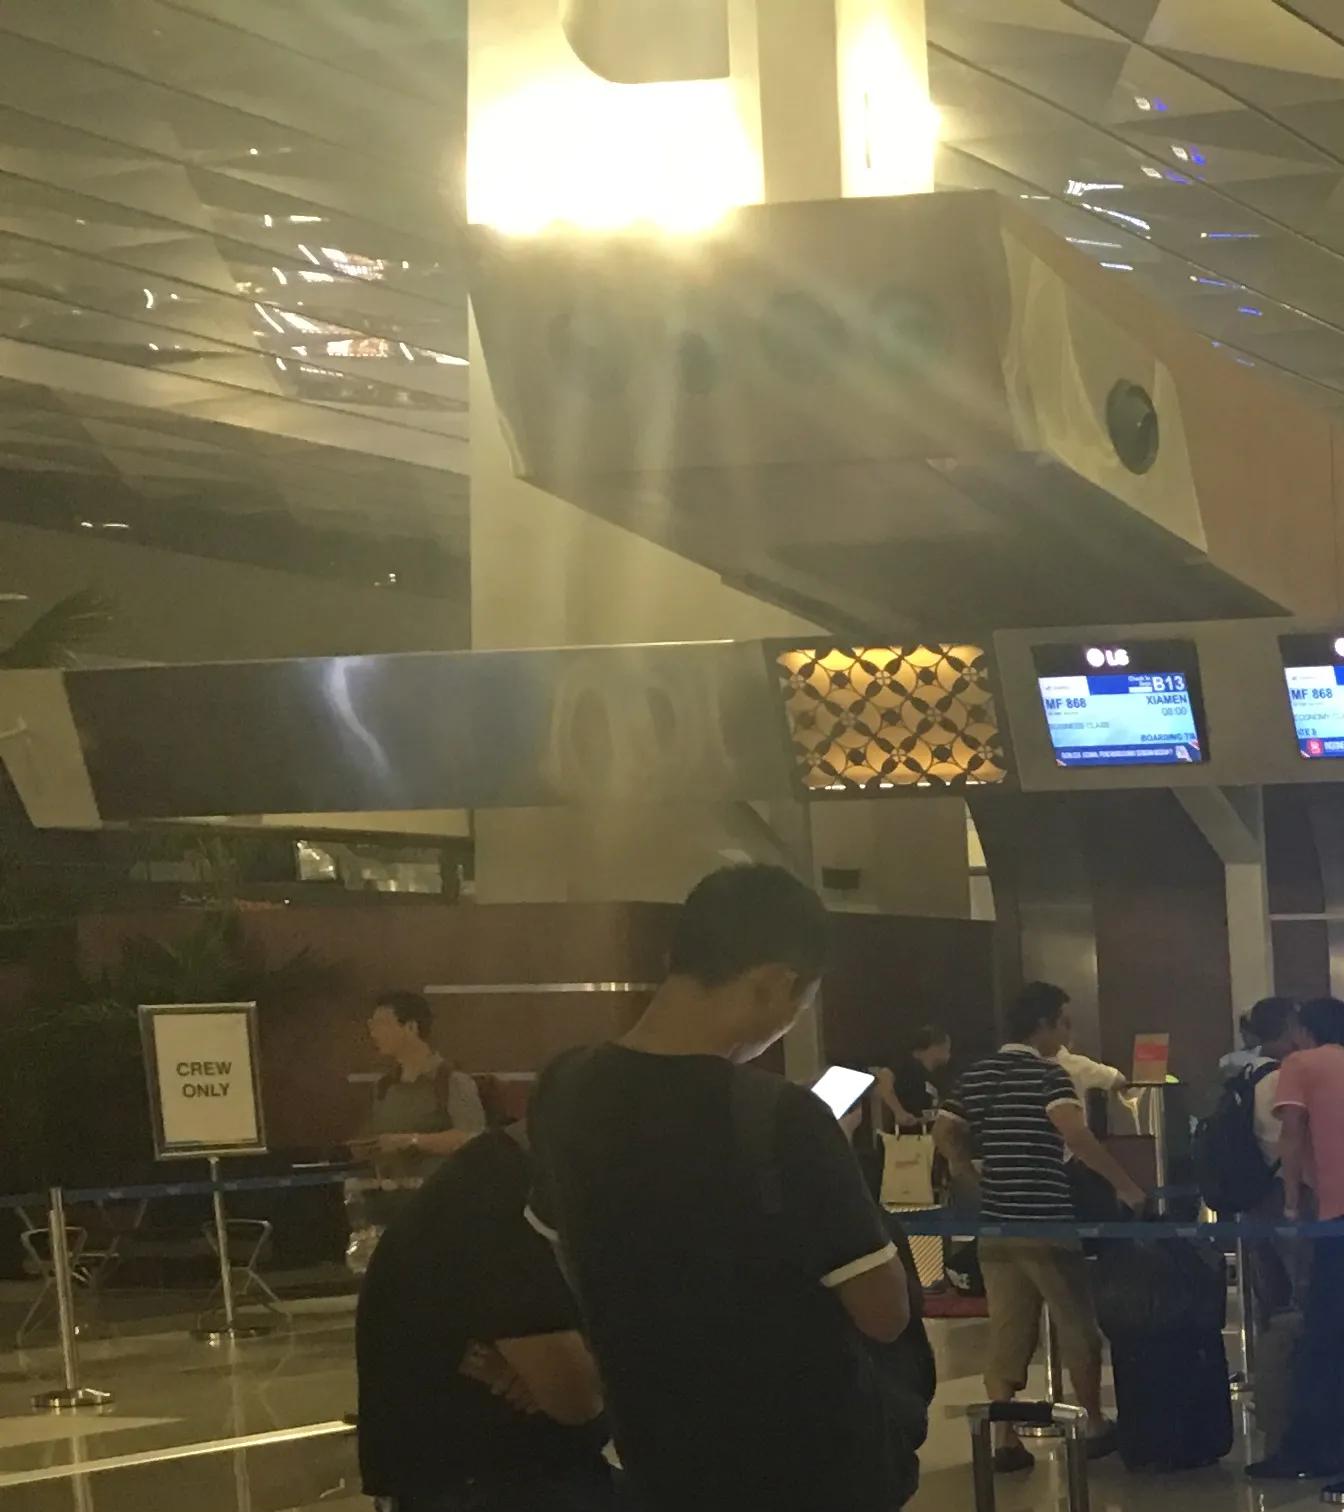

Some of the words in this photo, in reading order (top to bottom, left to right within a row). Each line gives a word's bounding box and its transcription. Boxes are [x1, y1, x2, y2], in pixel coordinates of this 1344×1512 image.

[1105, 649, 1129, 666] LG
[1152, 676, 1185, 691] B13
[1146, 695, 1187, 705] XIAMEN
[1291, 689, 1308, 700] MF
[1312, 688, 1333, 699] 868
[1045, 698, 1063, 709] MF
[1066, 698, 1087, 708] 868
[176, 1062, 232, 1077] CREW
[182, 1083, 230, 1098] ONLY
